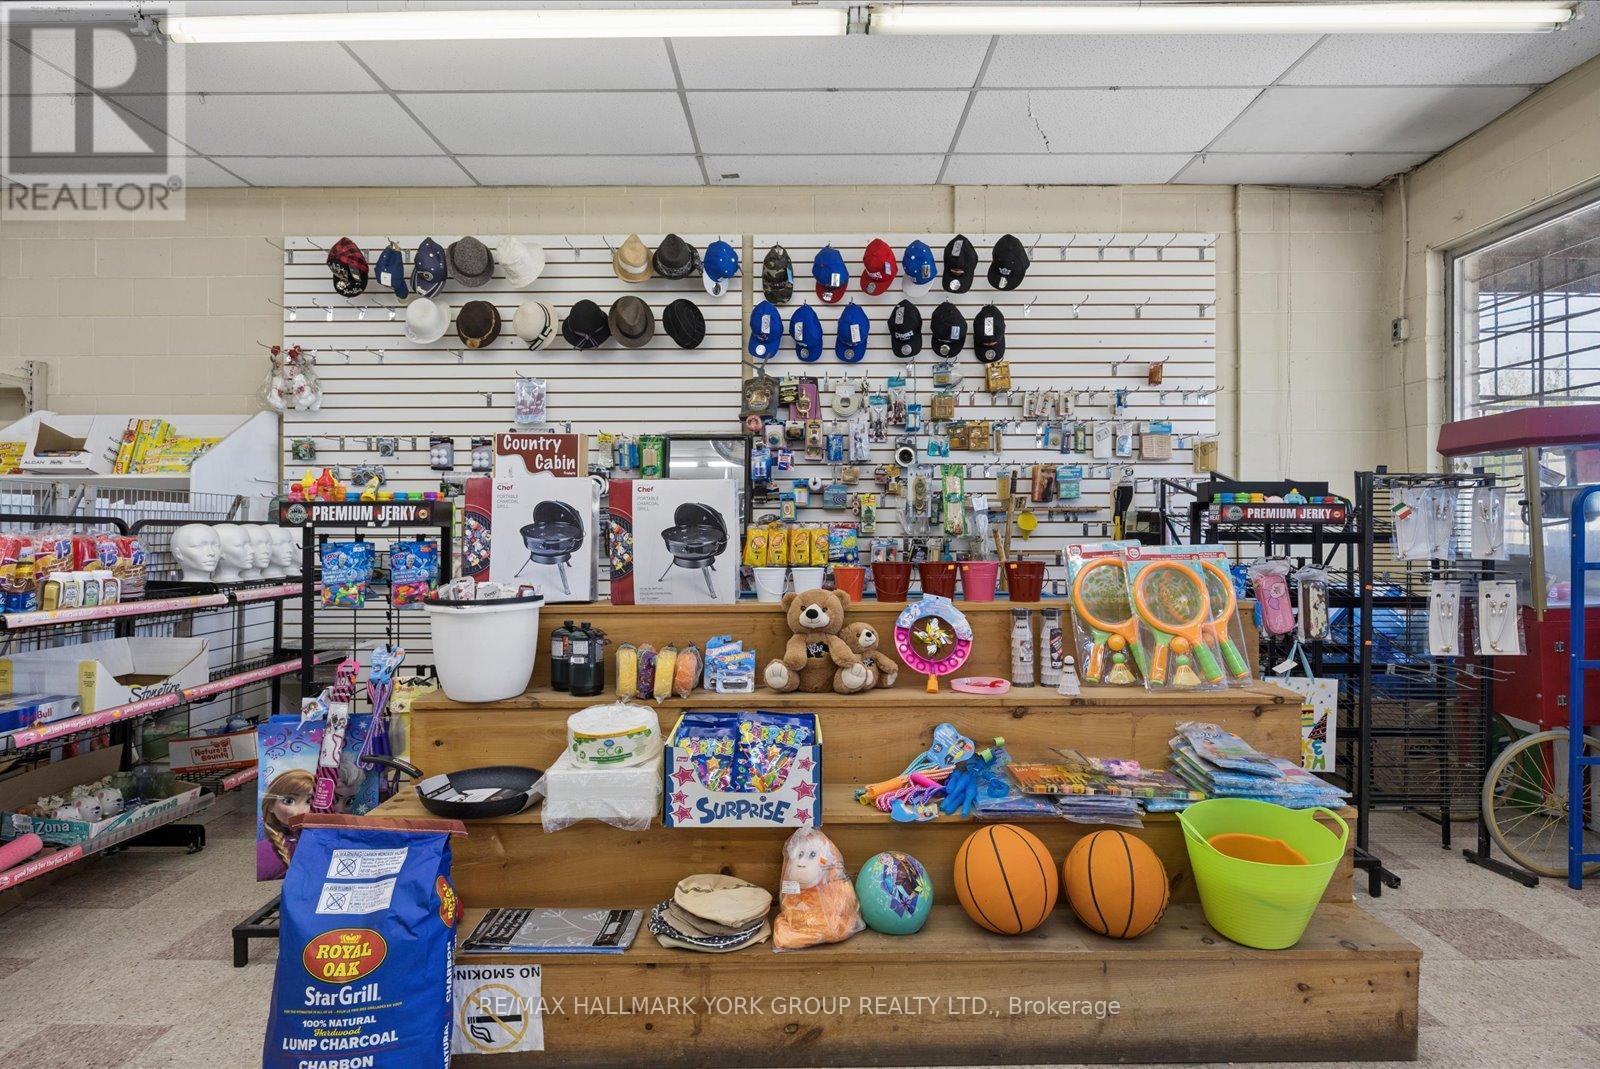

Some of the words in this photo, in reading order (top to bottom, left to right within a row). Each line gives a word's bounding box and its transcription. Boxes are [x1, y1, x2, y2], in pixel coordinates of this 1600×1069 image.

[503, 434, 562, 453] Country
[535, 453, 576, 470] Cabin
[312, 505, 373, 521] PREMIUM
[377, 505, 417, 521] JERKY
[1247, 507, 1296, 519] PREMIUM
[1300, 508, 1332, 520] JERKY
[55, 540, 72, 559] 15
[99, 551, 118, 567] 15
[37, 708, 53, 719] Bull
[201, 752, 229, 762] Bounty
[316, 942, 372, 960] ROYAL
[323, 961, 361, 977] OAK
[445, 941, 453, 1003] CHARBON
[452, 968, 515, 980] SMOKIN
[519, 966, 541, 979] NO
[302, 1019, 328, 1028] 100%
[329, 1015, 377, 1028] NATURAL
[313, 1026, 362, 1037] Hardwood
[282, 1037, 318, 1051] LUMP
[320, 1029, 399, 1051] CHARCOAL
[299, 1055, 374, 1069] CHARBON
